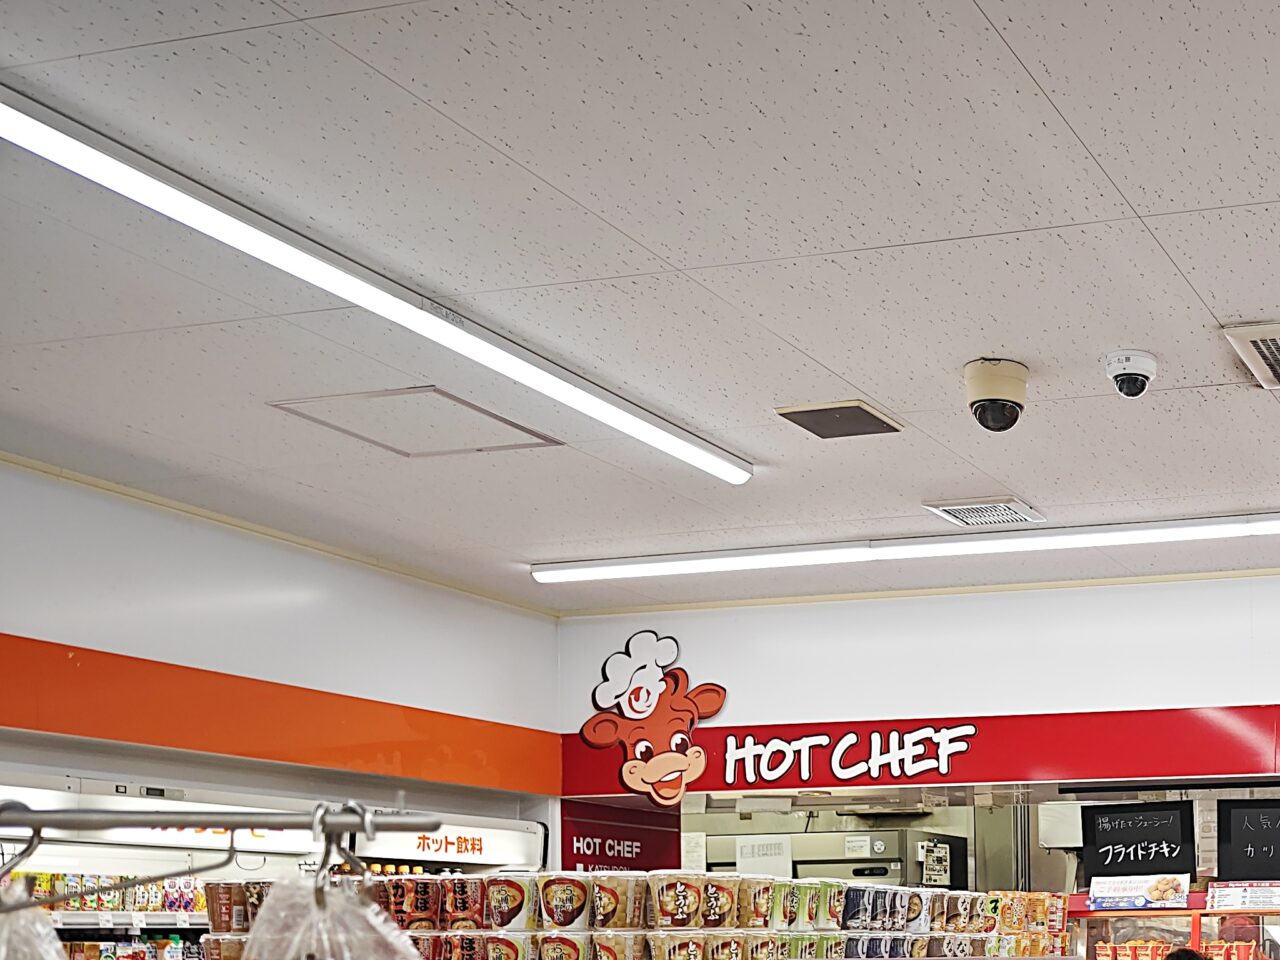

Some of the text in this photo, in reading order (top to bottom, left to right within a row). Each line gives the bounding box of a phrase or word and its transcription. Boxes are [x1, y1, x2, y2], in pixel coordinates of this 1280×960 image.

[725, 725, 976, 784] HOT CHEF
[417, 834, 483, 855] ホット飲料
[573, 836, 641, 858] HOT CHEF
[1098, 840, 1181, 865] フライドチキン
[673, 881, 688, 920] とうふ
[706, 883, 720, 920] とうふ
